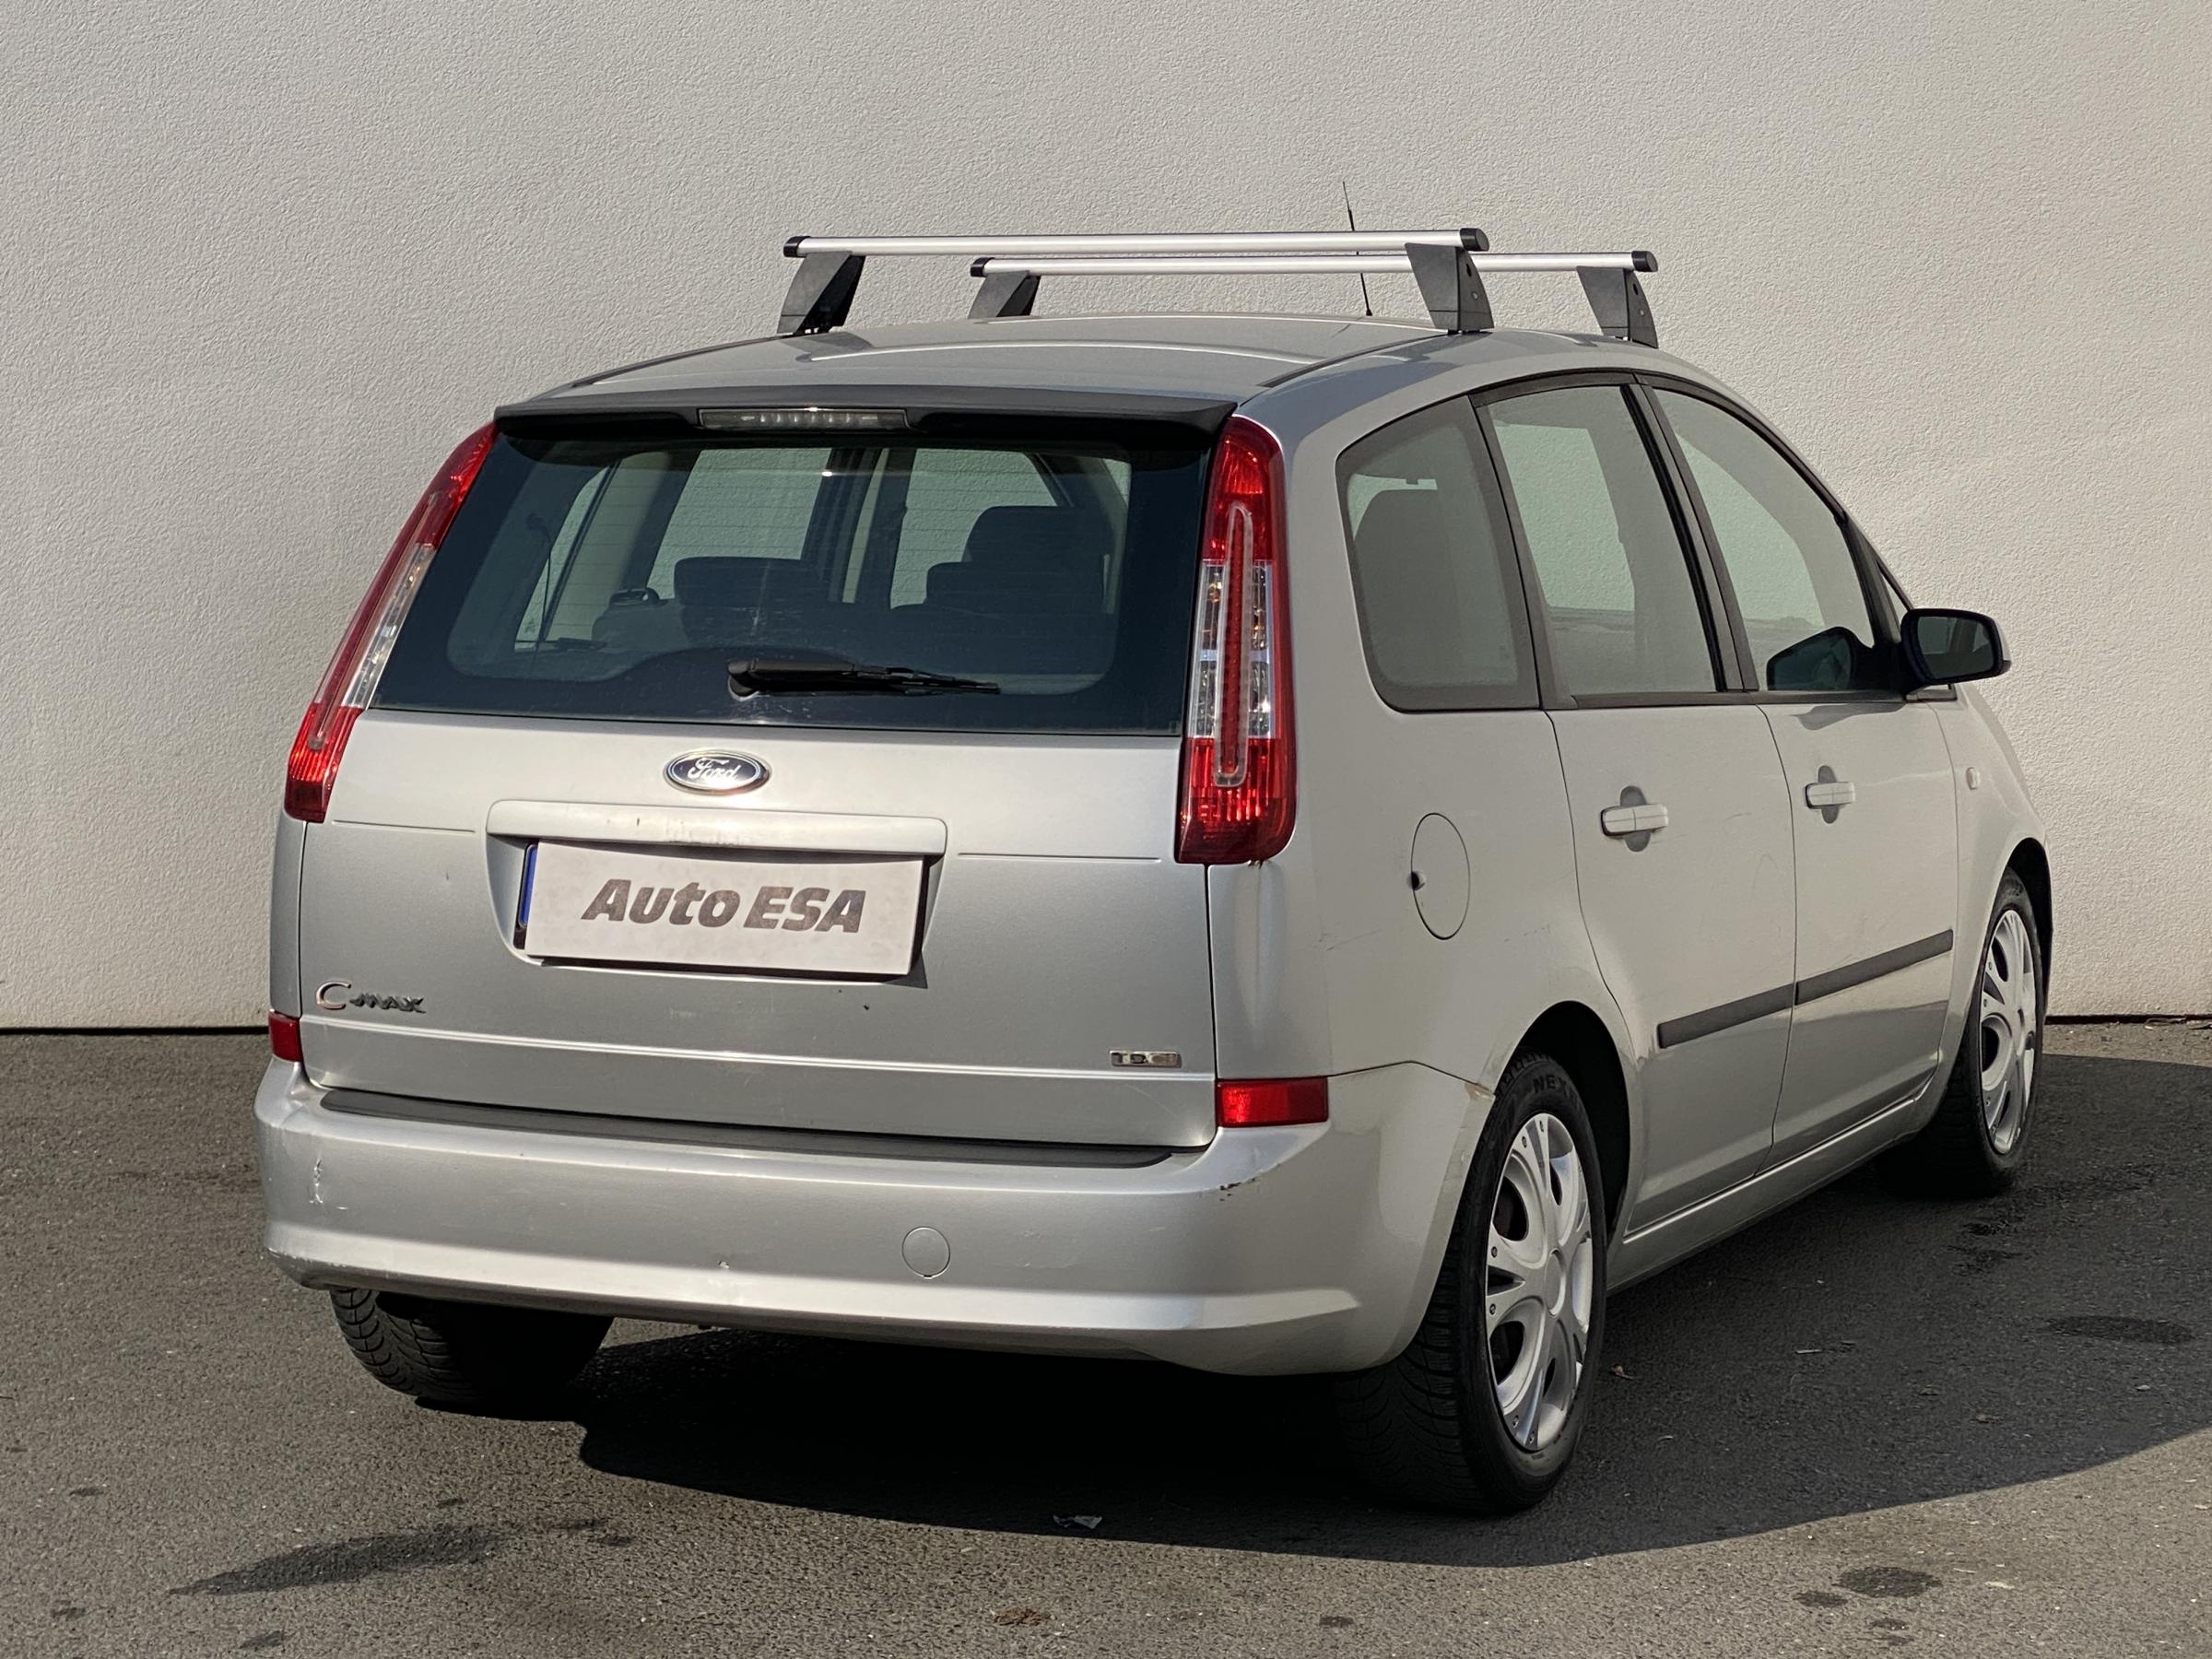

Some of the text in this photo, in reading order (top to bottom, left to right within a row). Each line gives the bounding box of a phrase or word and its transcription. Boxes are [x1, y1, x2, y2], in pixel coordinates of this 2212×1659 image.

[687, 756, 742, 781] Ford
[580, 877, 867, 934] Auto ESA
